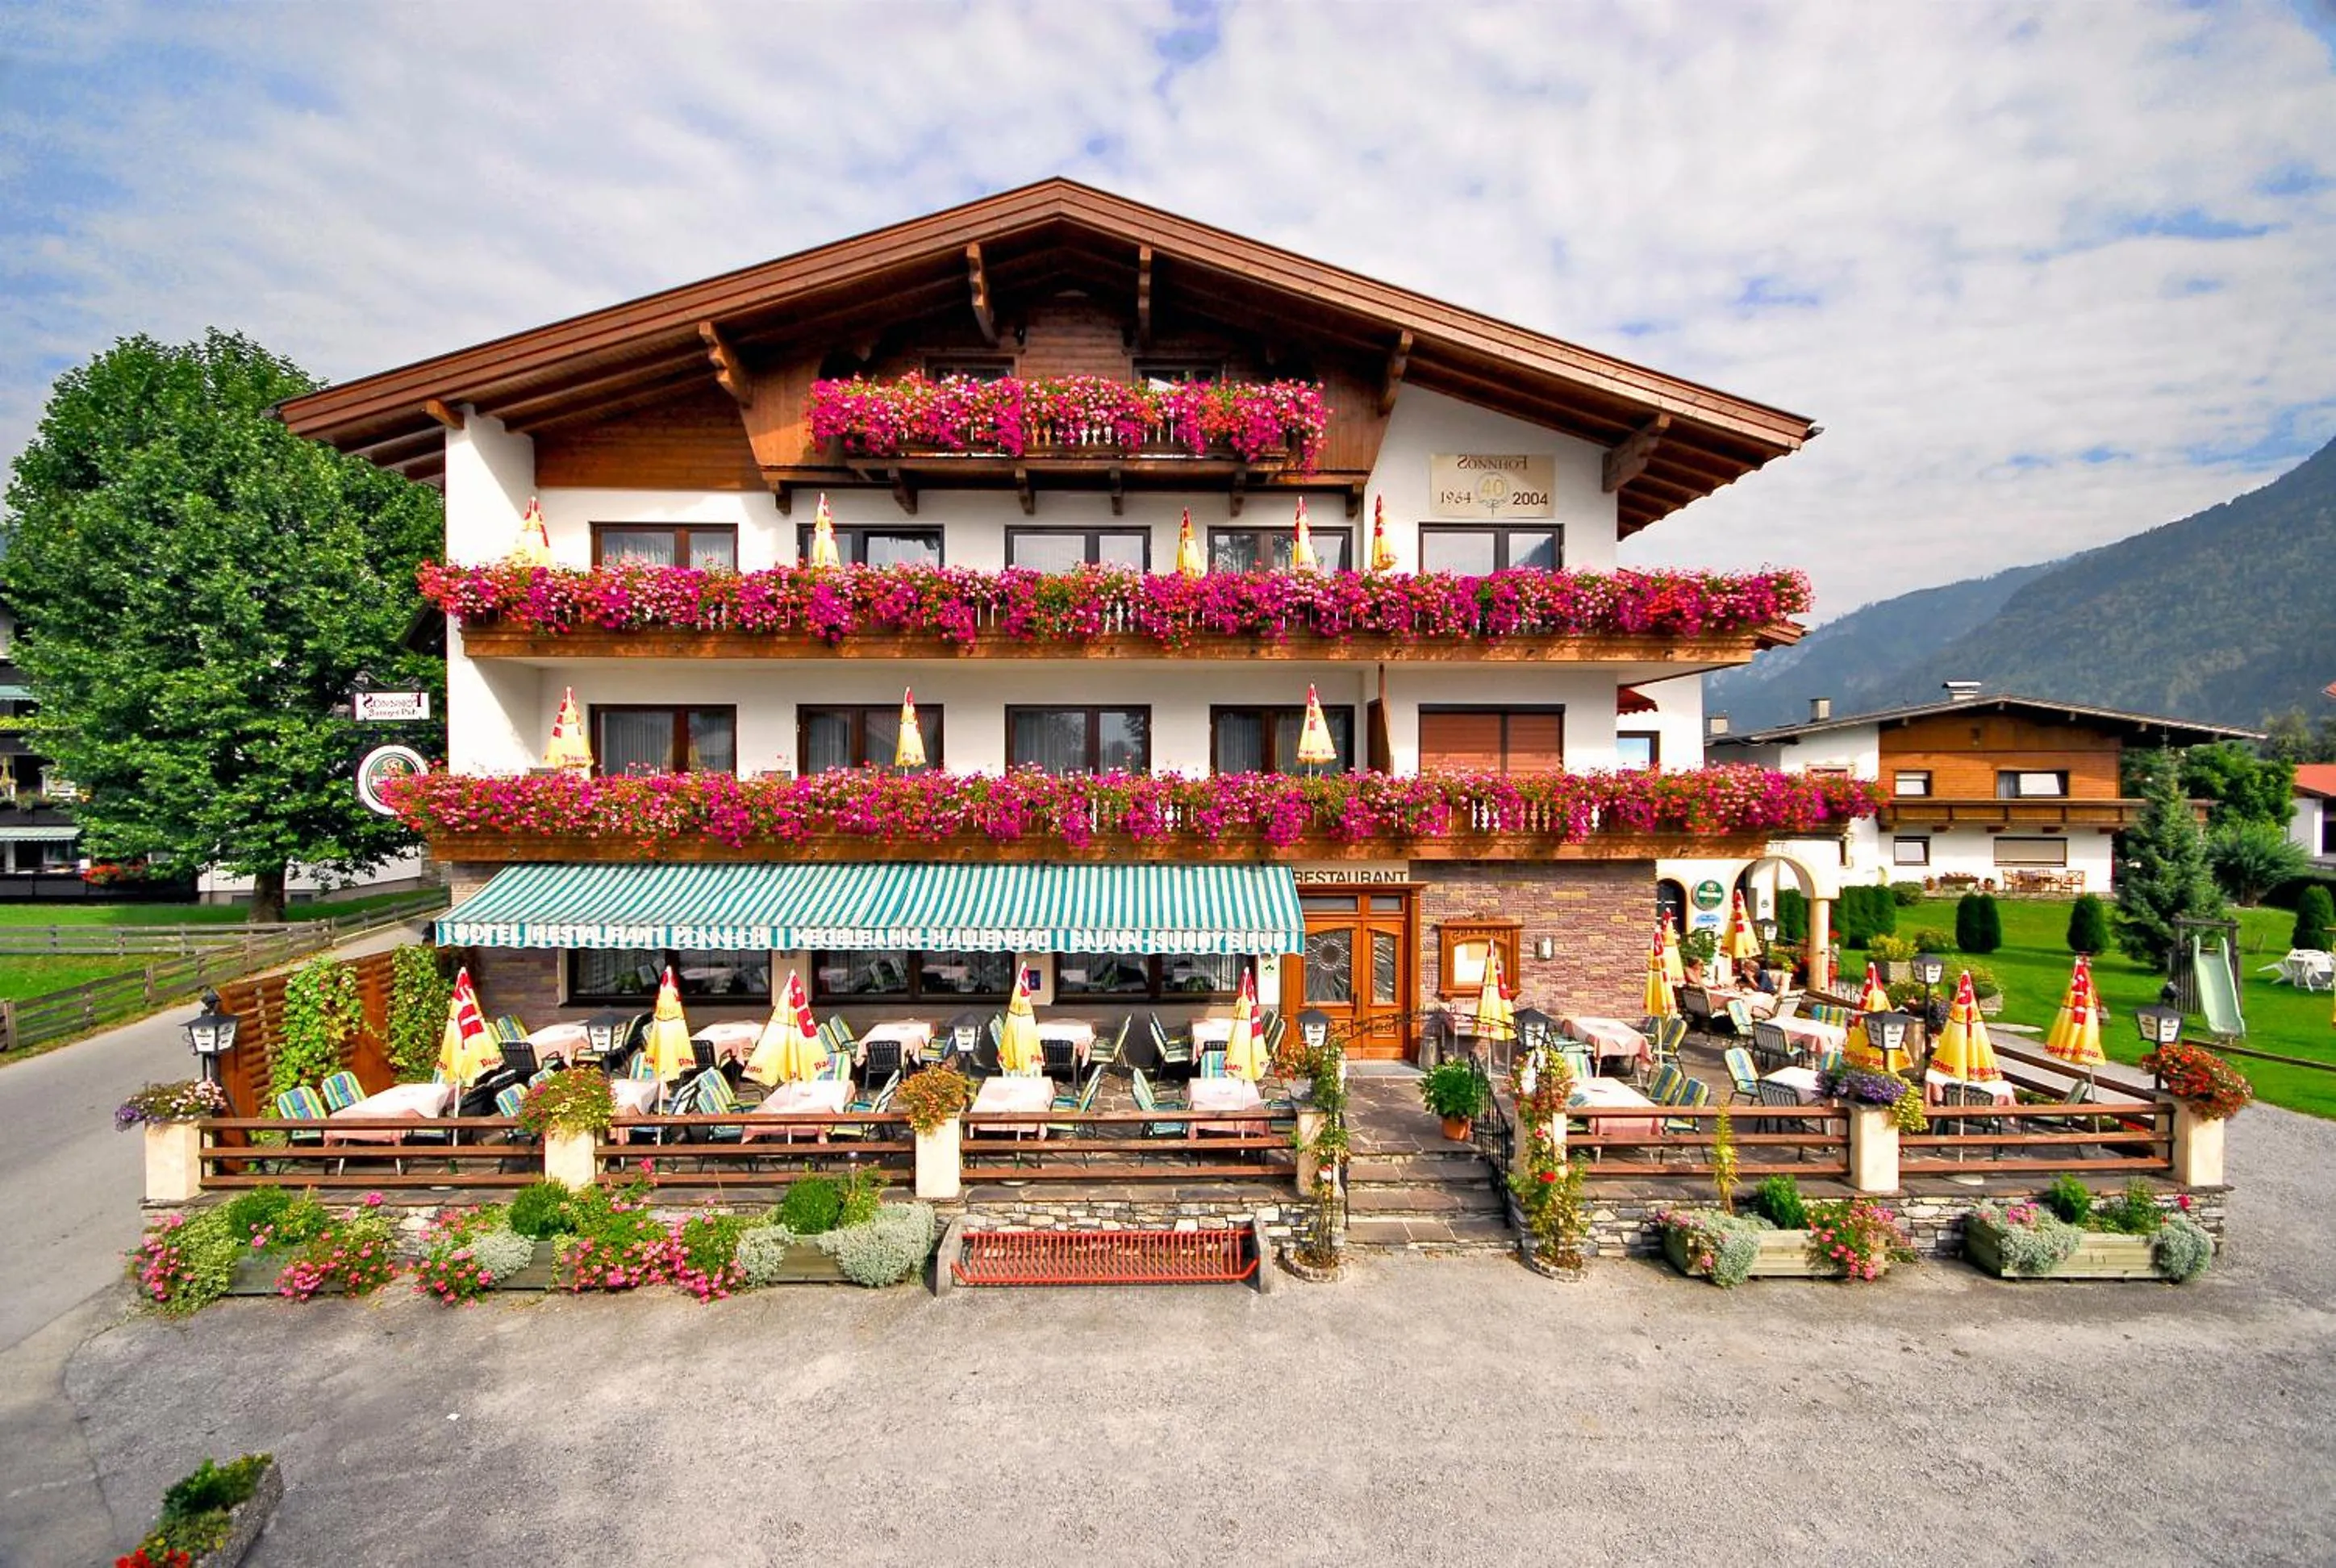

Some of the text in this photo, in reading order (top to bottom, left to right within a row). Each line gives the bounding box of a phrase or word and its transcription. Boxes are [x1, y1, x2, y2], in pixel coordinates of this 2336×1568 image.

[1481, 478, 1505, 494] 40
[1441, 490, 1471, 504] 1964
[1512, 492, 1549, 506] 2004
[1293, 870, 1407, 883] RESTAURANT
[454, 924, 522, 942] HOTEL
[532, 924, 665, 944] RESTAURANT
[793, 928, 917, 945] KEGELBAHN
[934, 928, 1049, 946] HALLENBAD
[1071, 929, 1138, 947] SAUNA
[1247, 931, 1286, 949] PUB
